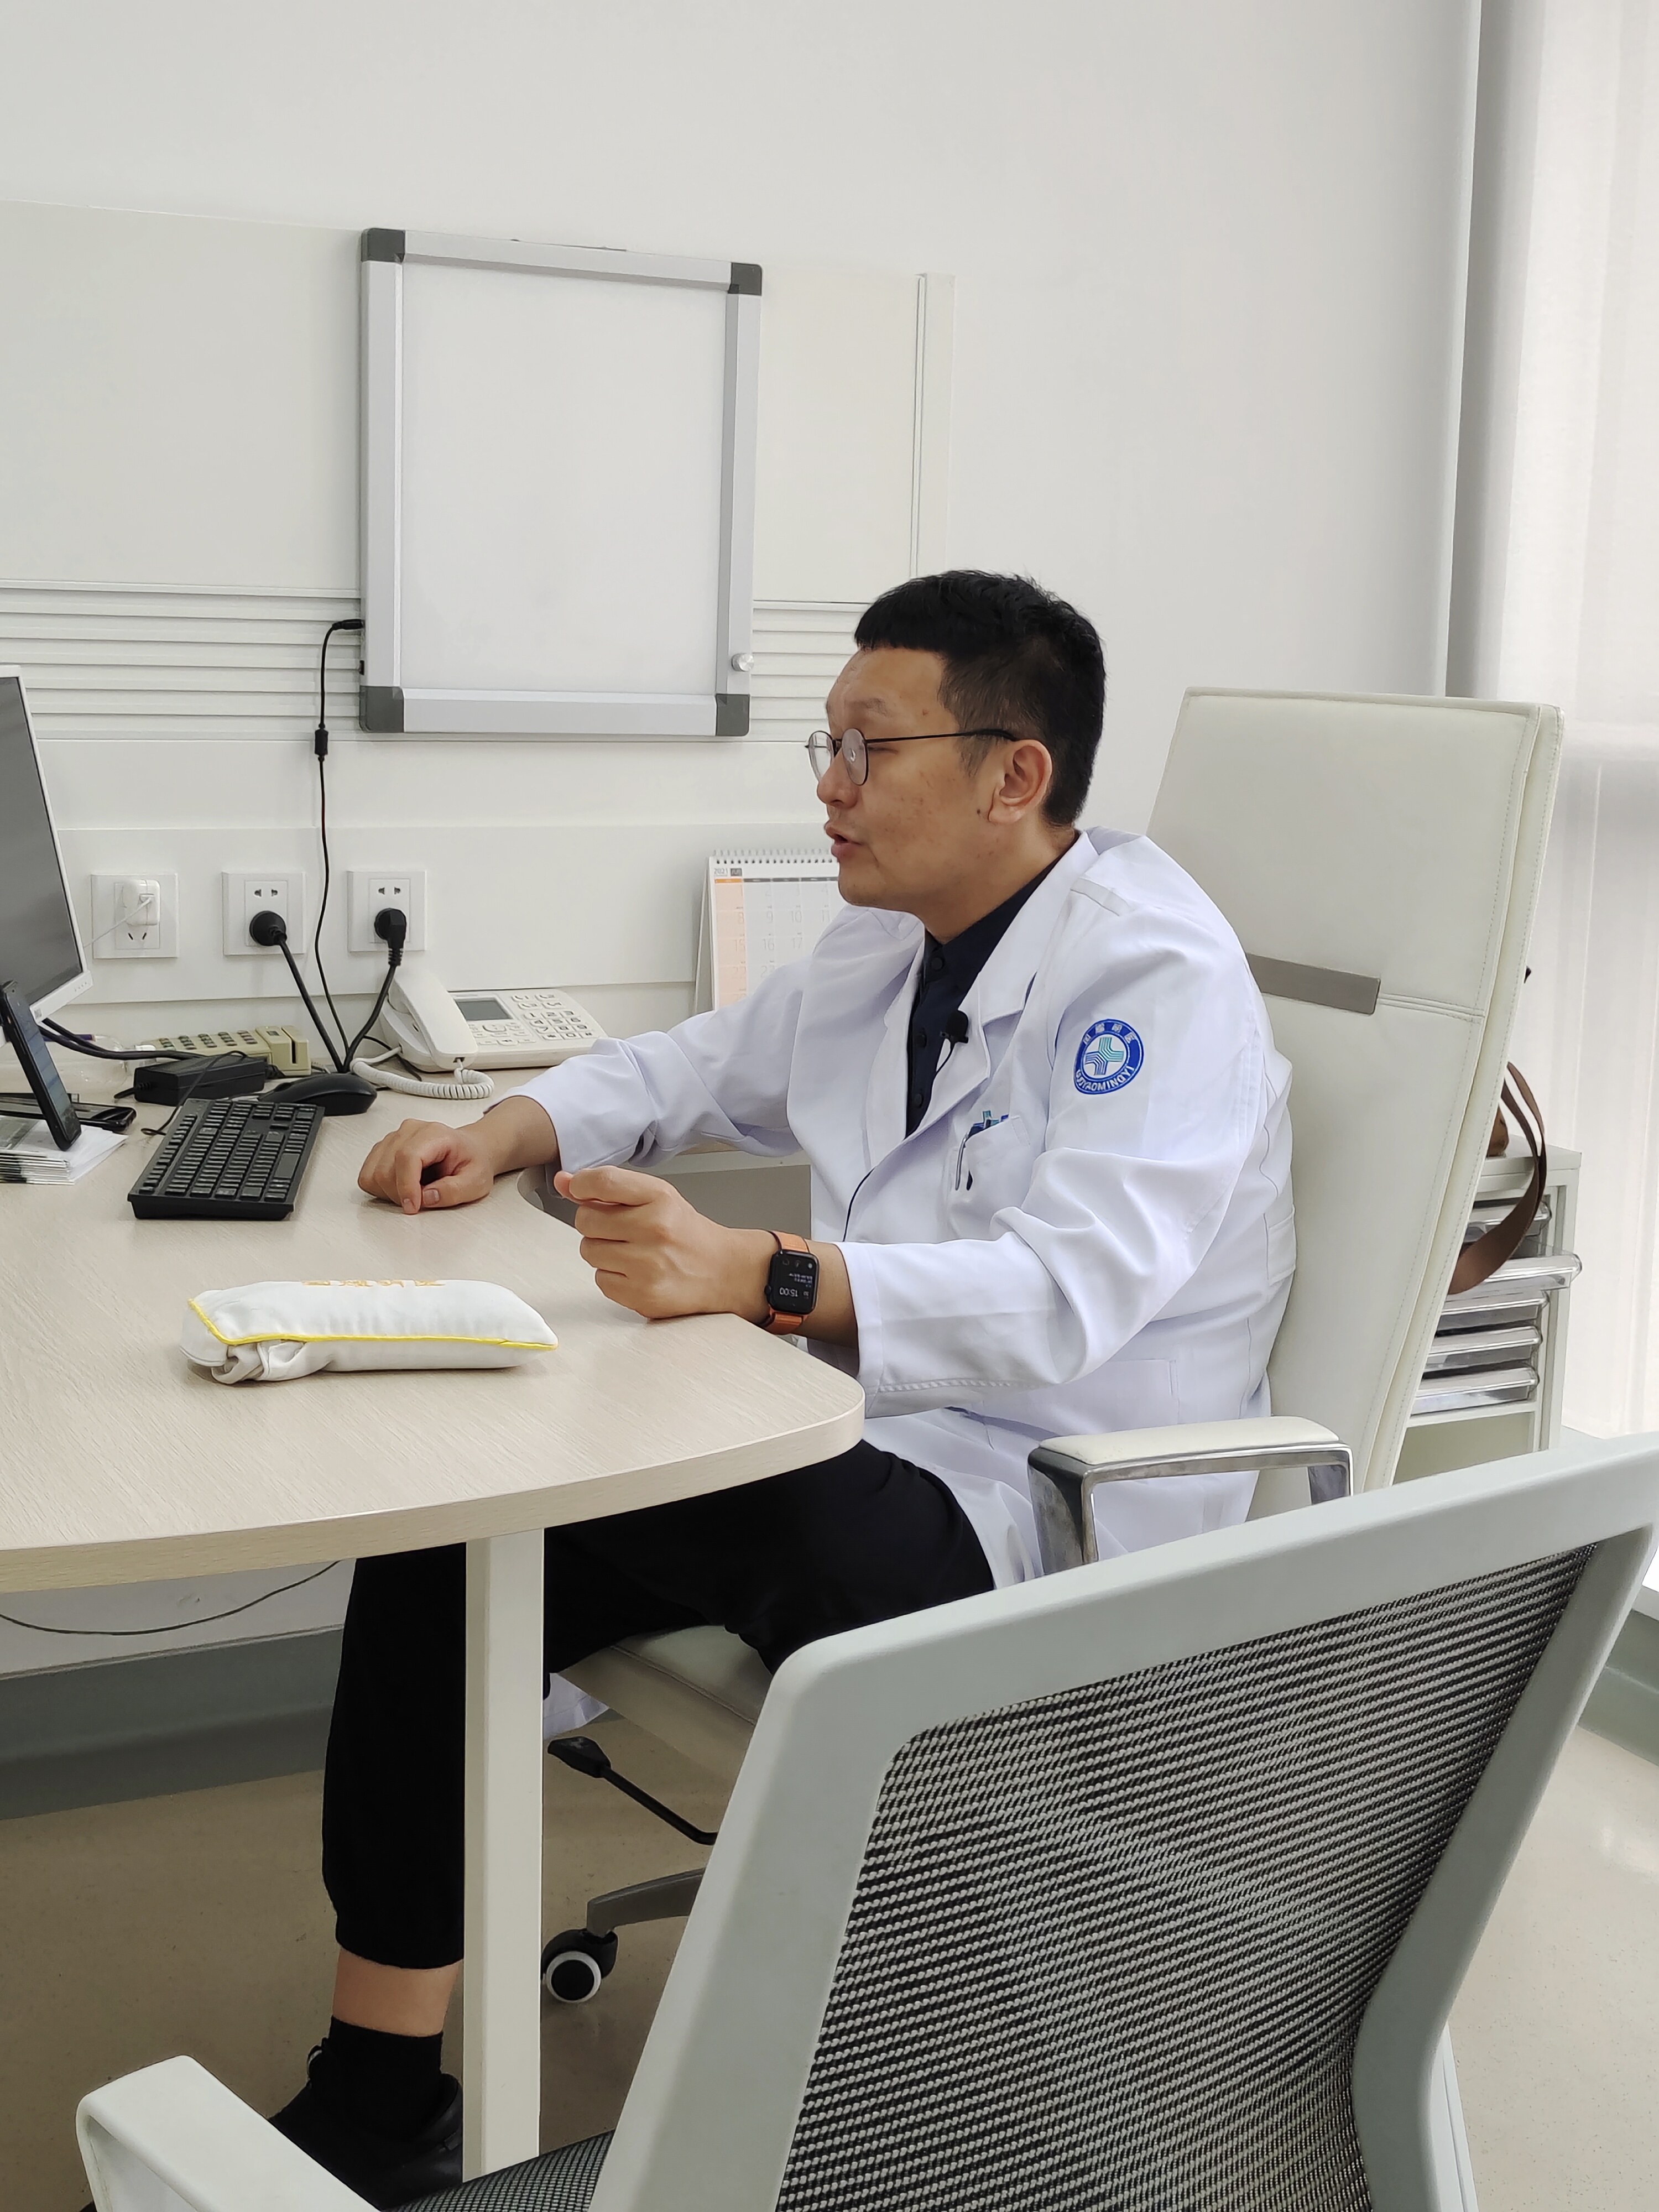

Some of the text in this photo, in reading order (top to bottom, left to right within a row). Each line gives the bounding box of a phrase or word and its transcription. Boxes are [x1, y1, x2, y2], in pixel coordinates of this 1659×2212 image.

[766, 911, 773, 924] 9
[791, 910, 802, 923] 10
[763, 938, 774, 951] 16
